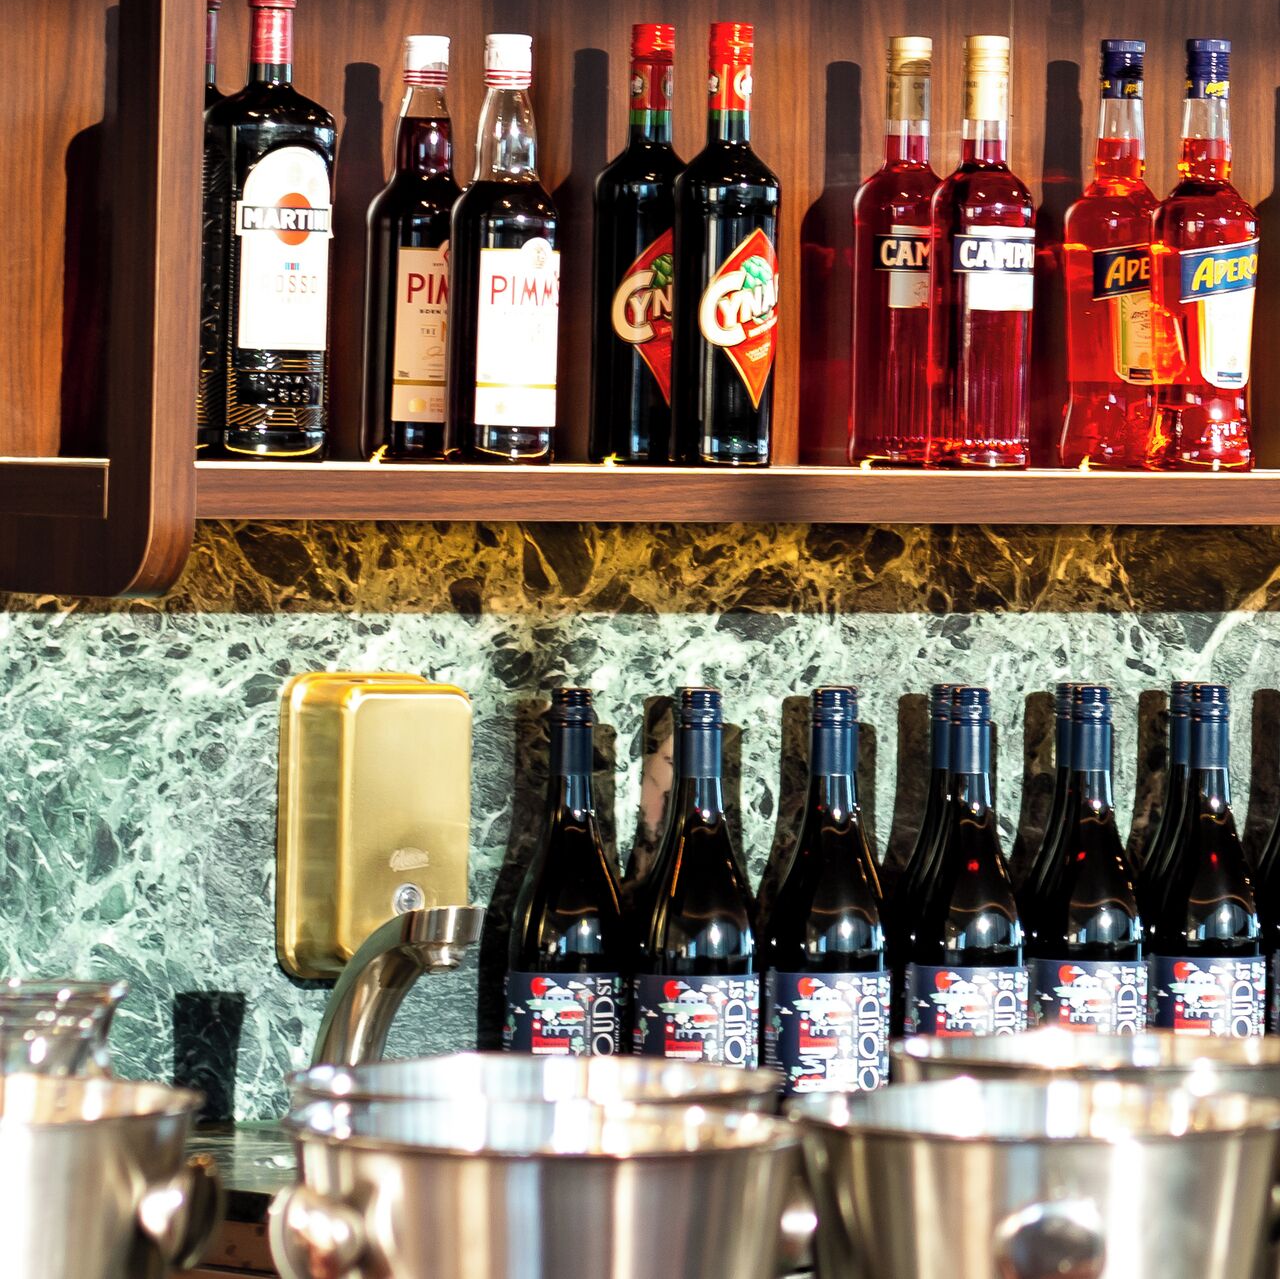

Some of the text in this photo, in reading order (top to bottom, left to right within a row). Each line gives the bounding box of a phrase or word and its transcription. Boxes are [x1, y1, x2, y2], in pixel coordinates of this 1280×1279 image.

[959, 239, 1035, 269] CAMPA
[1104, 255, 1151, 289] APE
[1191, 253, 1258, 291] APERO
[262, 275, 318, 294] OSSO
[612, 270, 673, 345] CYN
[699, 269, 779, 348] CYNA
